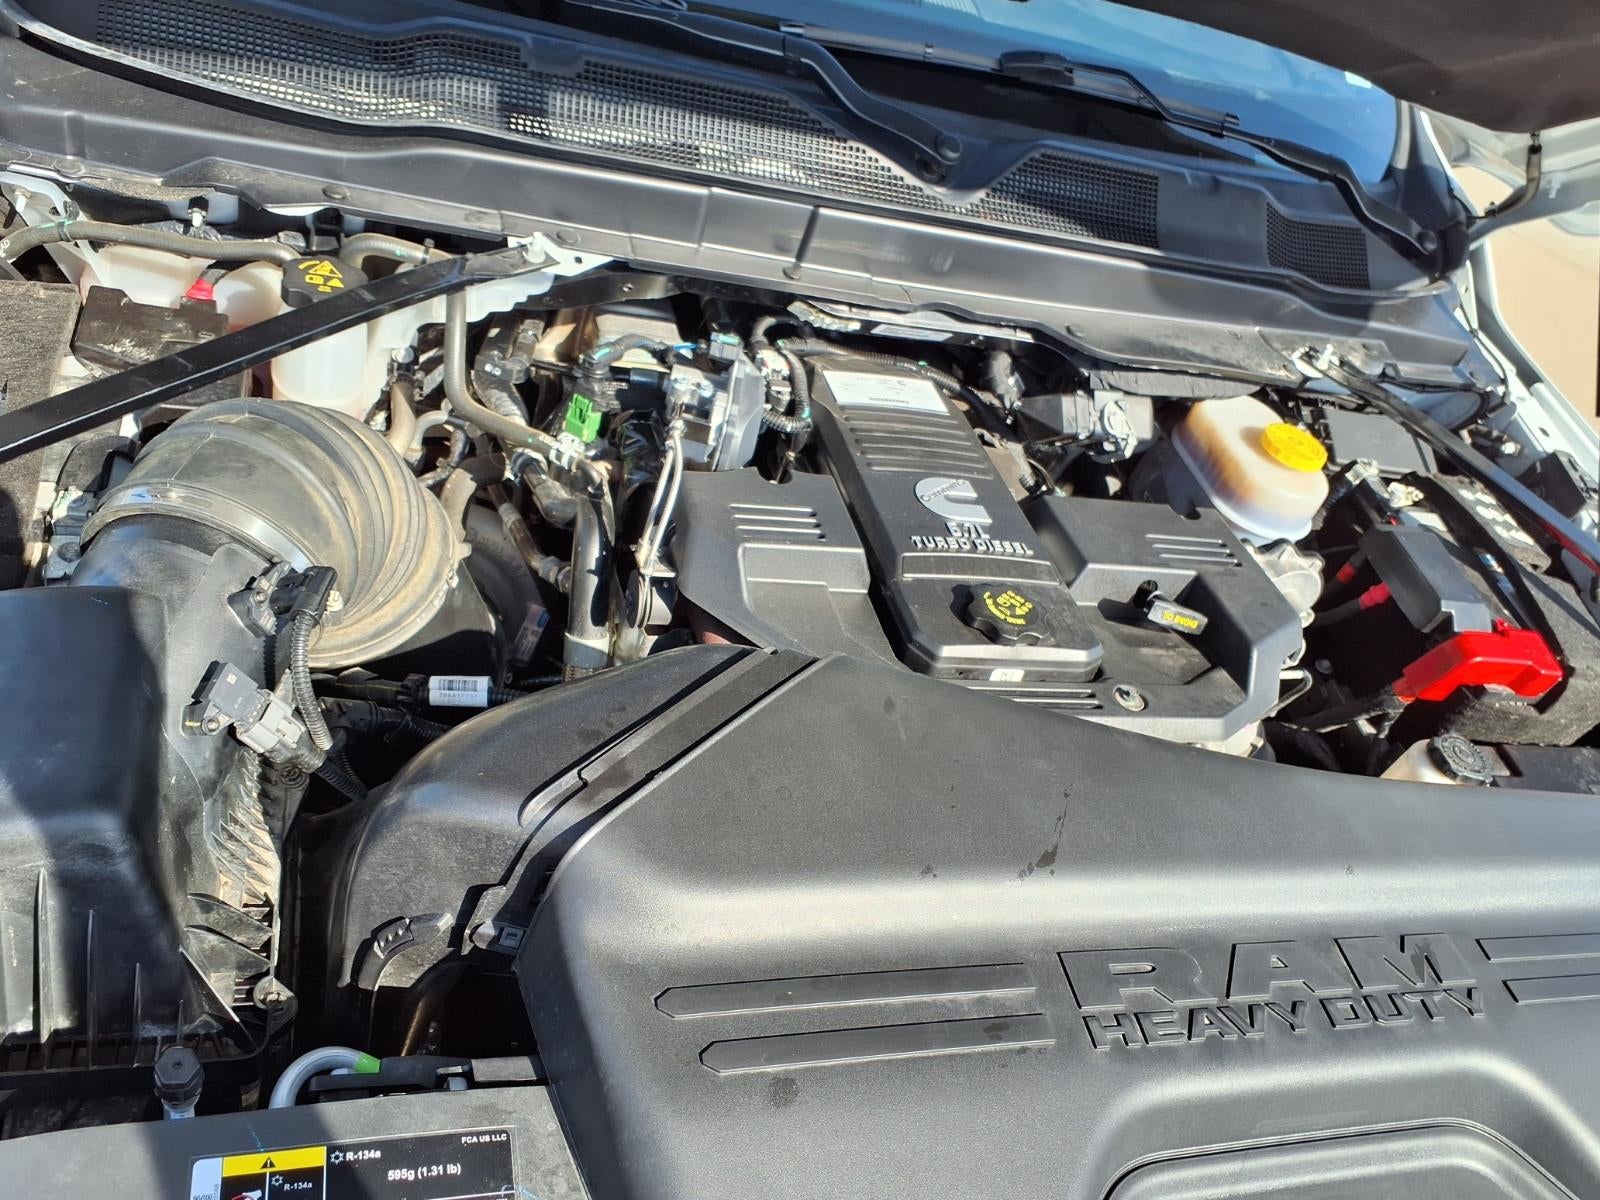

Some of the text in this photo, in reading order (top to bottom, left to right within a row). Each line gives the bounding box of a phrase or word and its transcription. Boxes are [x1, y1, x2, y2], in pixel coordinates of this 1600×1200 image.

[920, 479, 967, 502] Cummins
[945, 520, 990, 539] 6.7L
[910, 535, 1034, 555] TURBO DIESEL
[1056, 932, 1477, 1009] RAM
[1082, 987, 1485, 1049] HEAVY DUTY
[461, 1133, 507, 1144] FCA US LLC
[346, 1149, 381, 1161] R-134a
[387, 1162, 461, 1181] 595g (1.31 lb)
[283, 1181, 313, 1191] R-134a
